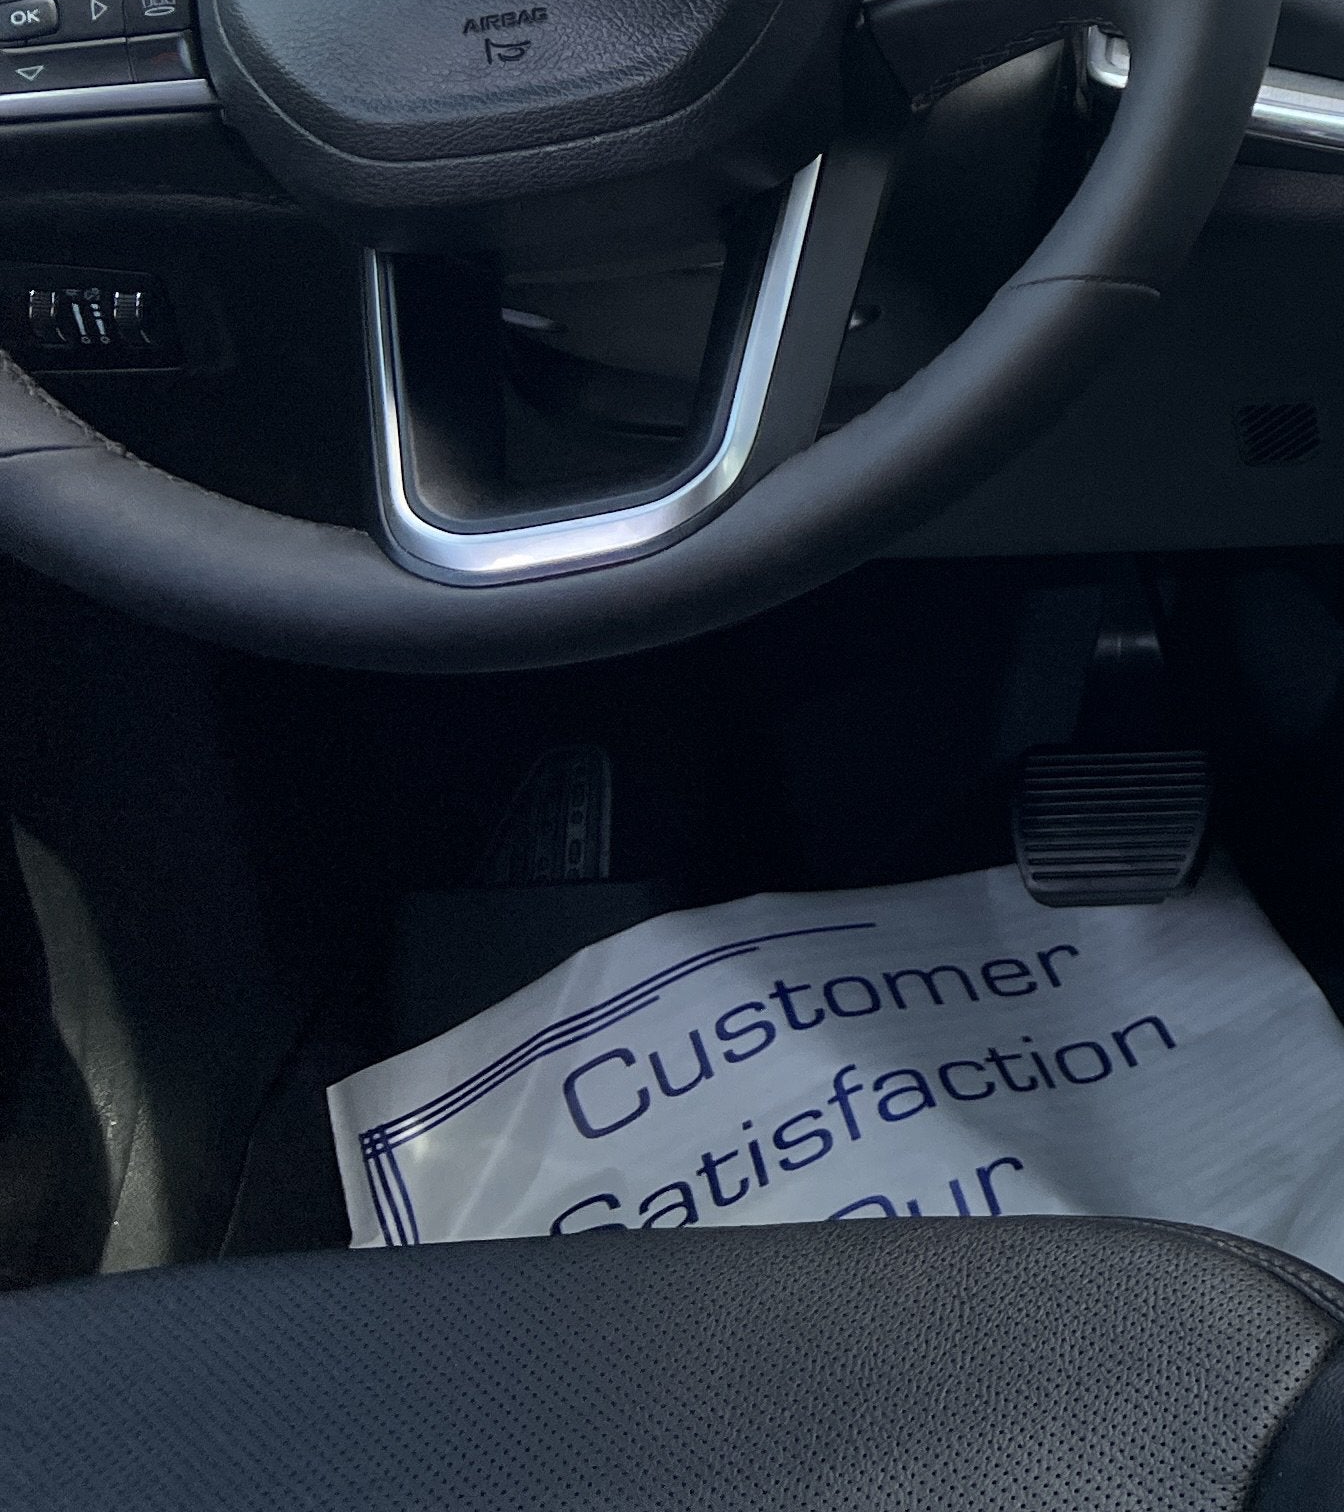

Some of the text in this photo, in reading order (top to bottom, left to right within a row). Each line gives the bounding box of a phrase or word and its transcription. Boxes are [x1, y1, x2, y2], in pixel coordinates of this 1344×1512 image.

[10, 7, 42, 26] OK
[462, 6, 550, 35] AIRBAG
[562, 942, 1081, 1140] Customer
